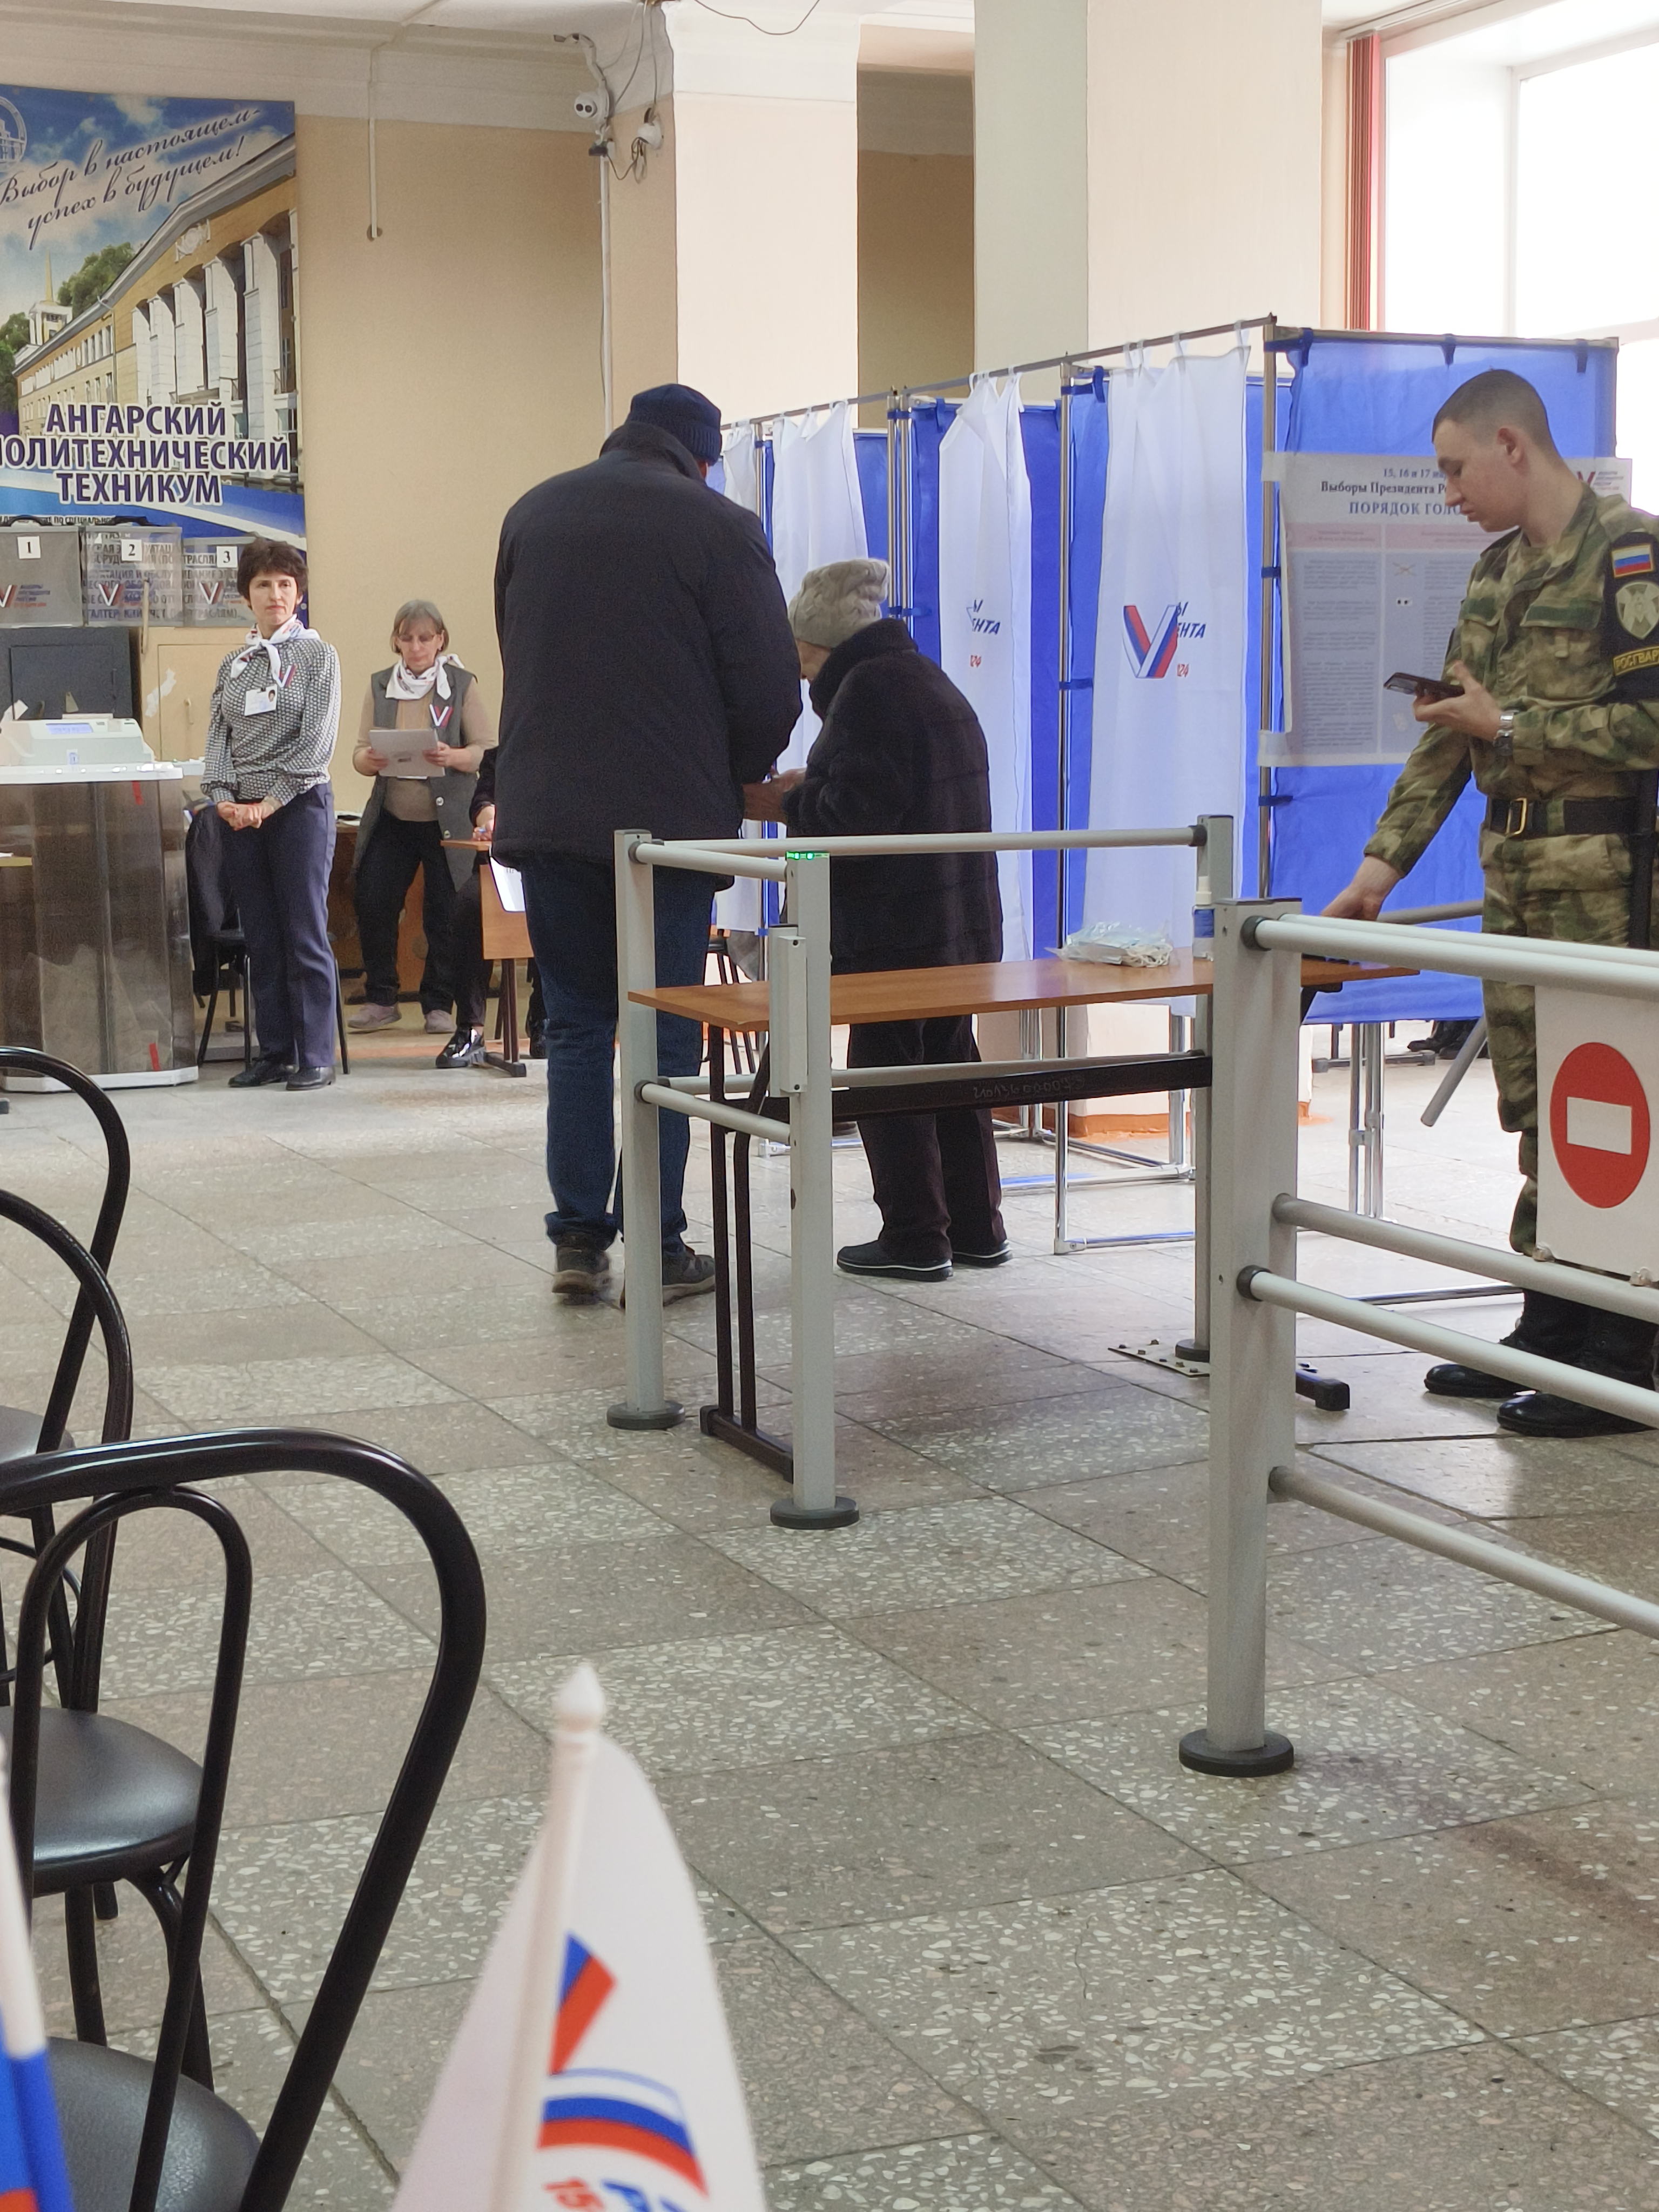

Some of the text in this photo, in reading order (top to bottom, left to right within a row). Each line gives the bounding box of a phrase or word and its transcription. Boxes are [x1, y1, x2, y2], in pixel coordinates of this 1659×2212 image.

[0, 161, 77, 208] Выбор
[85, 139, 103, 176] в
[28, 135, 245, 251] успех в будущем!
[46, 401, 226, 436] АНГАРСКИЙ
[56, 473, 220, 503] ТЕХНИКУМ
[1321, 481, 1367, 496] Выборы
[1370, 482, 1434, 496] Президента
[1349, 502, 1420, 516] ПОРЯДОК
[27, 541, 31, 554] 1
[128, 544, 136, 556] 2
[223, 550, 230, 563] 3
[1615, 649, 1659, 671] РОСГВАР
